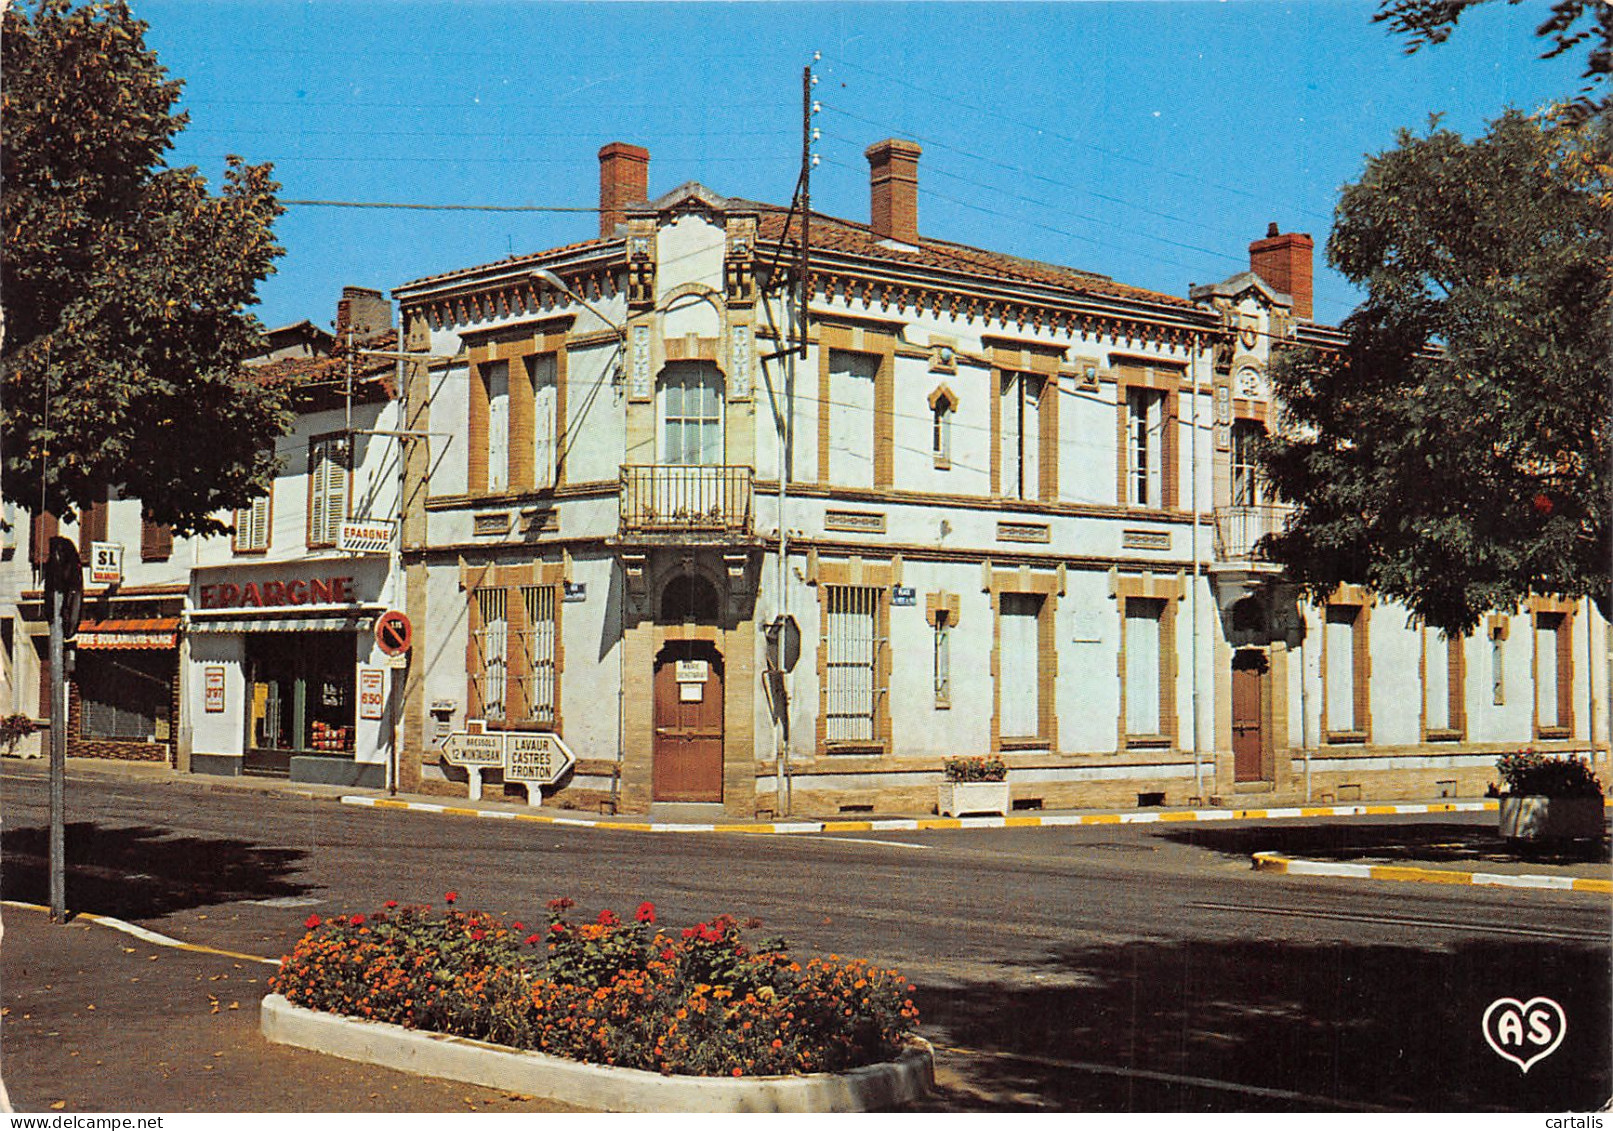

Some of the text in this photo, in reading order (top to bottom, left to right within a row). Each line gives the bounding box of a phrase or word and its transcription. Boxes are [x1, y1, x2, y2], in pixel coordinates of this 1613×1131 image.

[344, 527, 389, 540] EPARGNE
[200, 577, 357, 609] EPARGNE
[515, 739, 549, 751] LAVAUR
[452, 748, 500, 761] 12 MONTAUBAN
[512, 752, 551, 765] CASTRES
[512, 765, 551, 778] FRONTON
